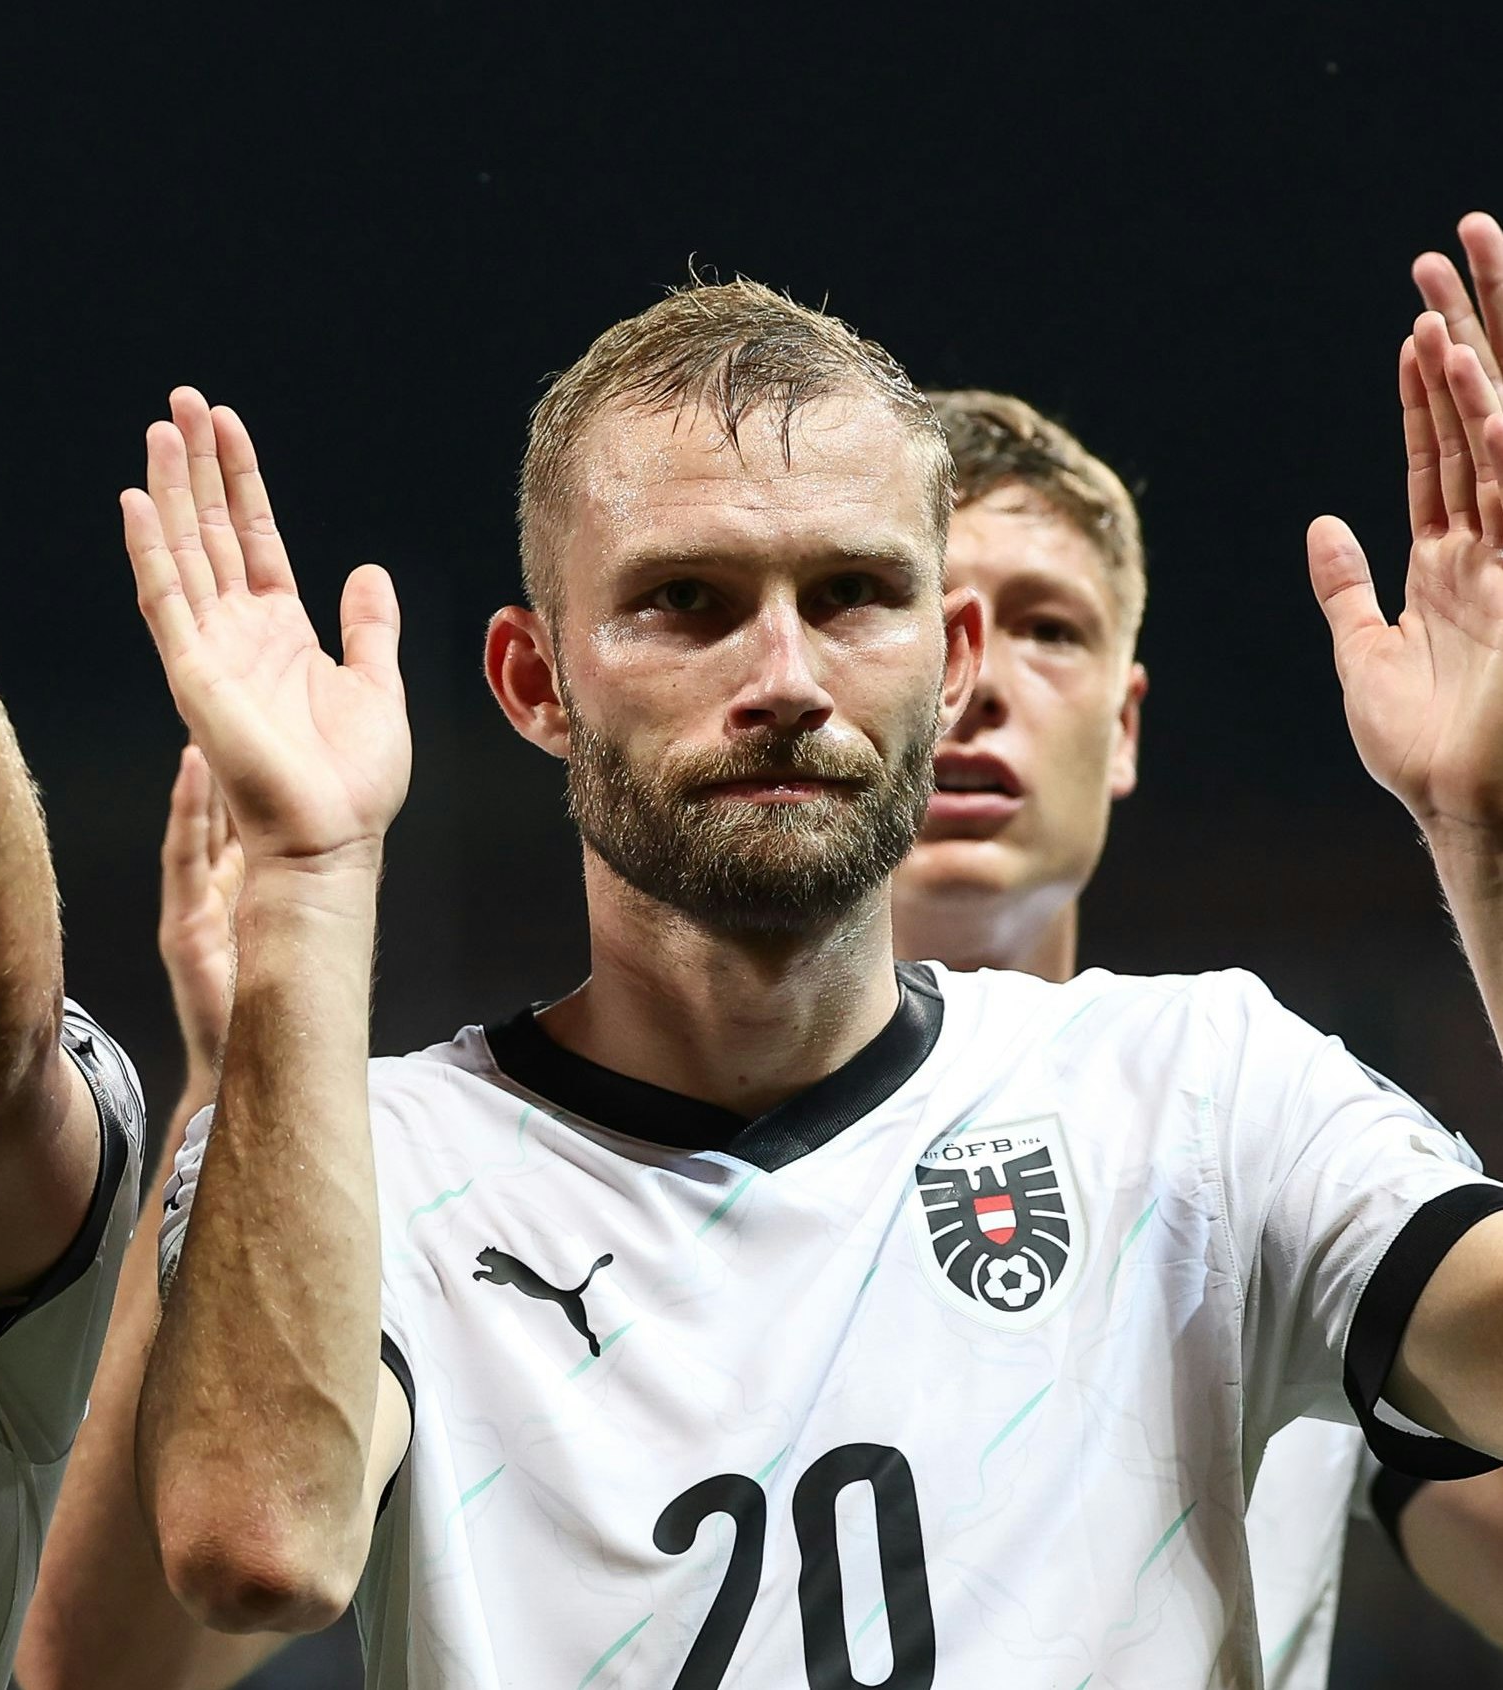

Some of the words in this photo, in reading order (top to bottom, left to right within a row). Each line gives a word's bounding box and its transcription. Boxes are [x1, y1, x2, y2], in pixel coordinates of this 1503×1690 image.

[920, 1151, 938, 1160] EIT
[942, 1138, 1013, 1161] ÖFB
[652, 1442, 936, 1690] 20
